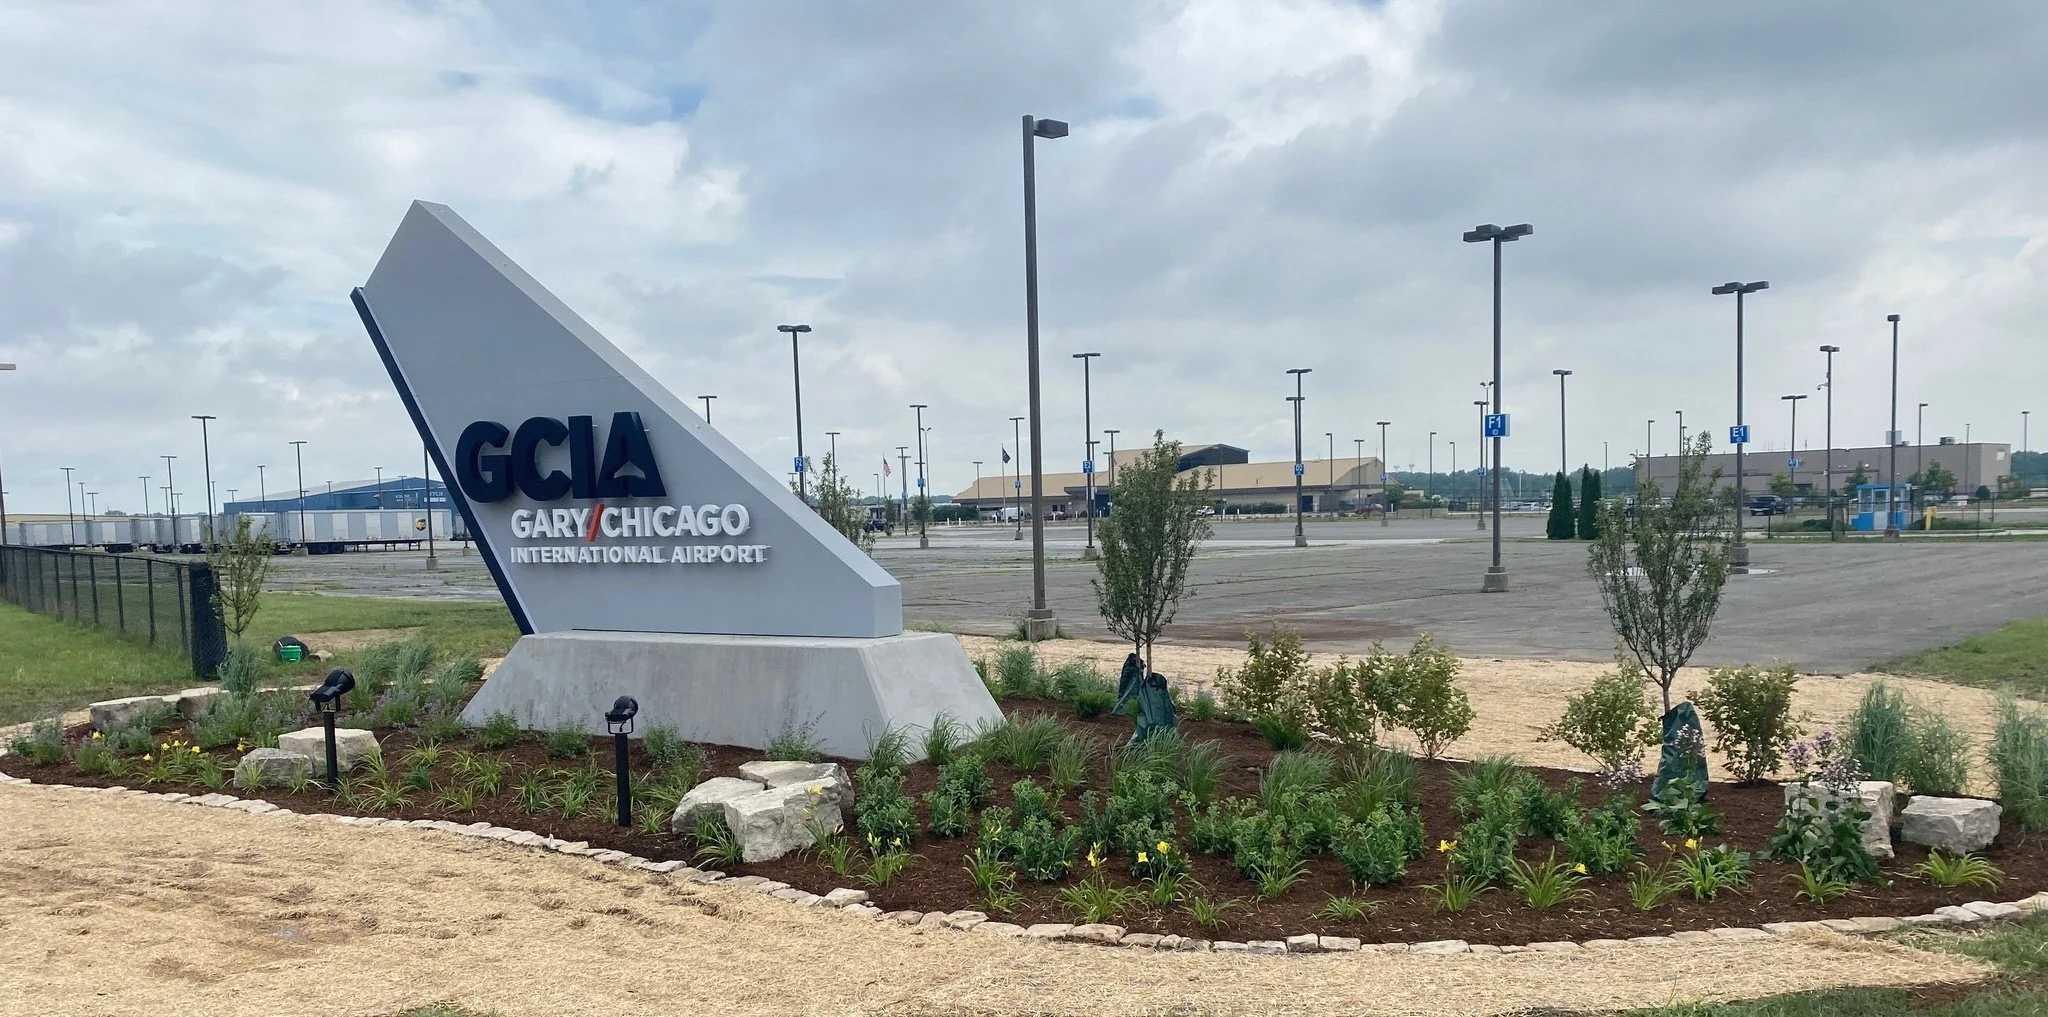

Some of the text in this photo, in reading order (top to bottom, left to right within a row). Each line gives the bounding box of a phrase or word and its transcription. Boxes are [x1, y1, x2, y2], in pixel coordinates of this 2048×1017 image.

[1488, 416, 1501, 429] F1
[1732, 427, 1744, 438] E1
[455, 411, 667, 503] GCIA
[511, 503, 750, 542] GARY/CHICAGO
[510, 545, 769, 563] INTERNATIONAL AIRPORT
